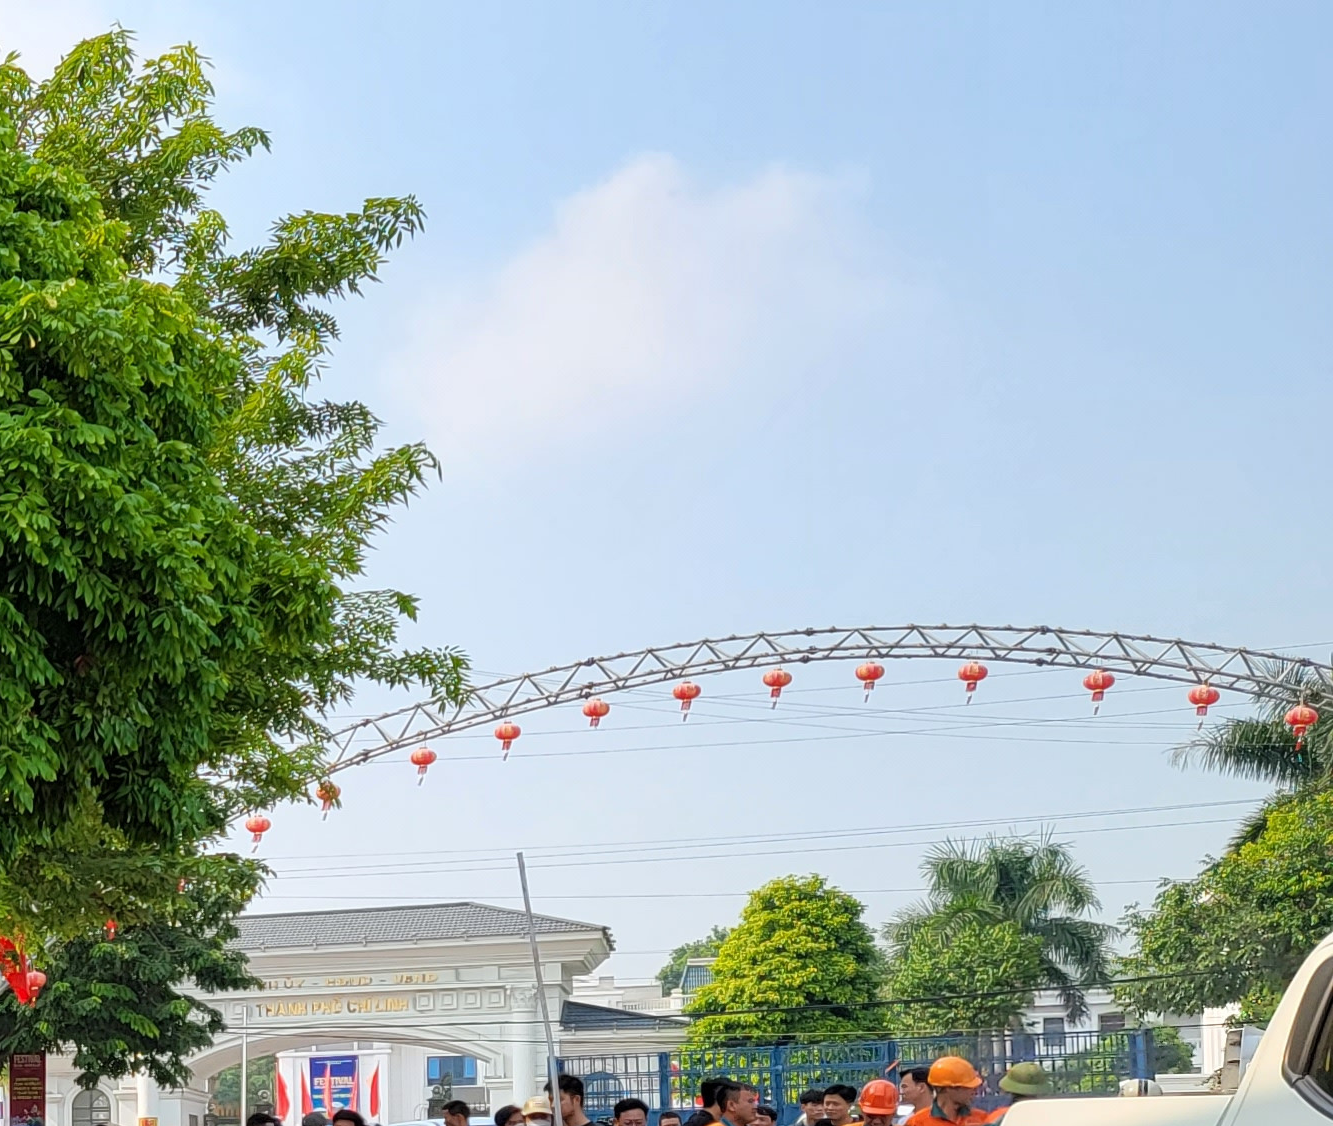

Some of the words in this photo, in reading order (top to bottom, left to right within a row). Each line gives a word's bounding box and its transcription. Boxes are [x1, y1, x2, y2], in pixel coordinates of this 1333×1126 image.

[255, 999, 308, 1018] THÀNH
[311, 997, 343, 1016] PHỐ
[347, 998, 372, 1014] CHÍ
[375, 997, 410, 1013] LINH
[13, 1054, 42, 1065] FESTIVAL
[313, 1076, 354, 1086] FETIVAL
